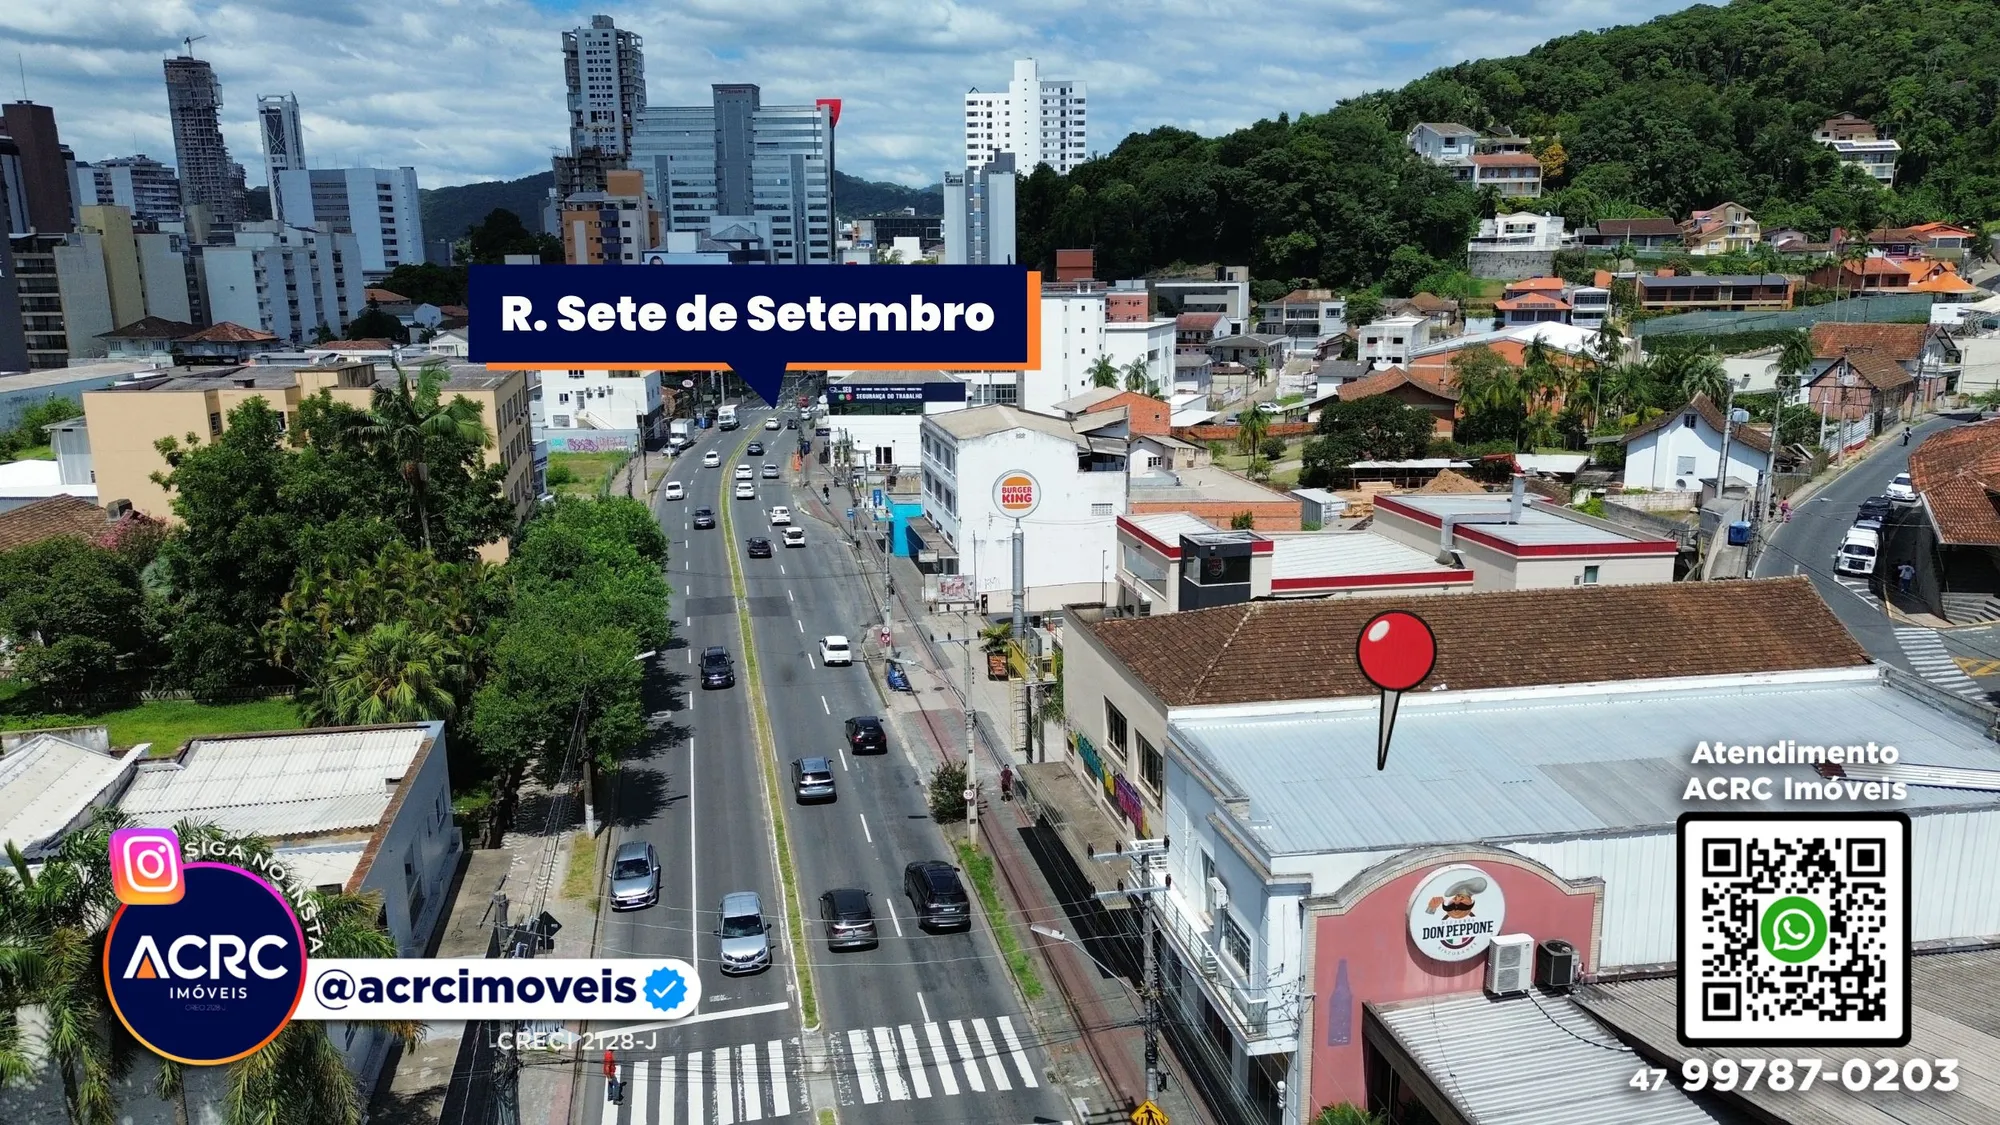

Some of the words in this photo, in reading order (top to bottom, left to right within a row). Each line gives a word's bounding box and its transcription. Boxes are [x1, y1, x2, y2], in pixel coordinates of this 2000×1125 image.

[1002, 494, 1032, 503] KING
[1422, 925, 1445, 940] DON
[1446, 920, 1494, 938] PEPPONE
